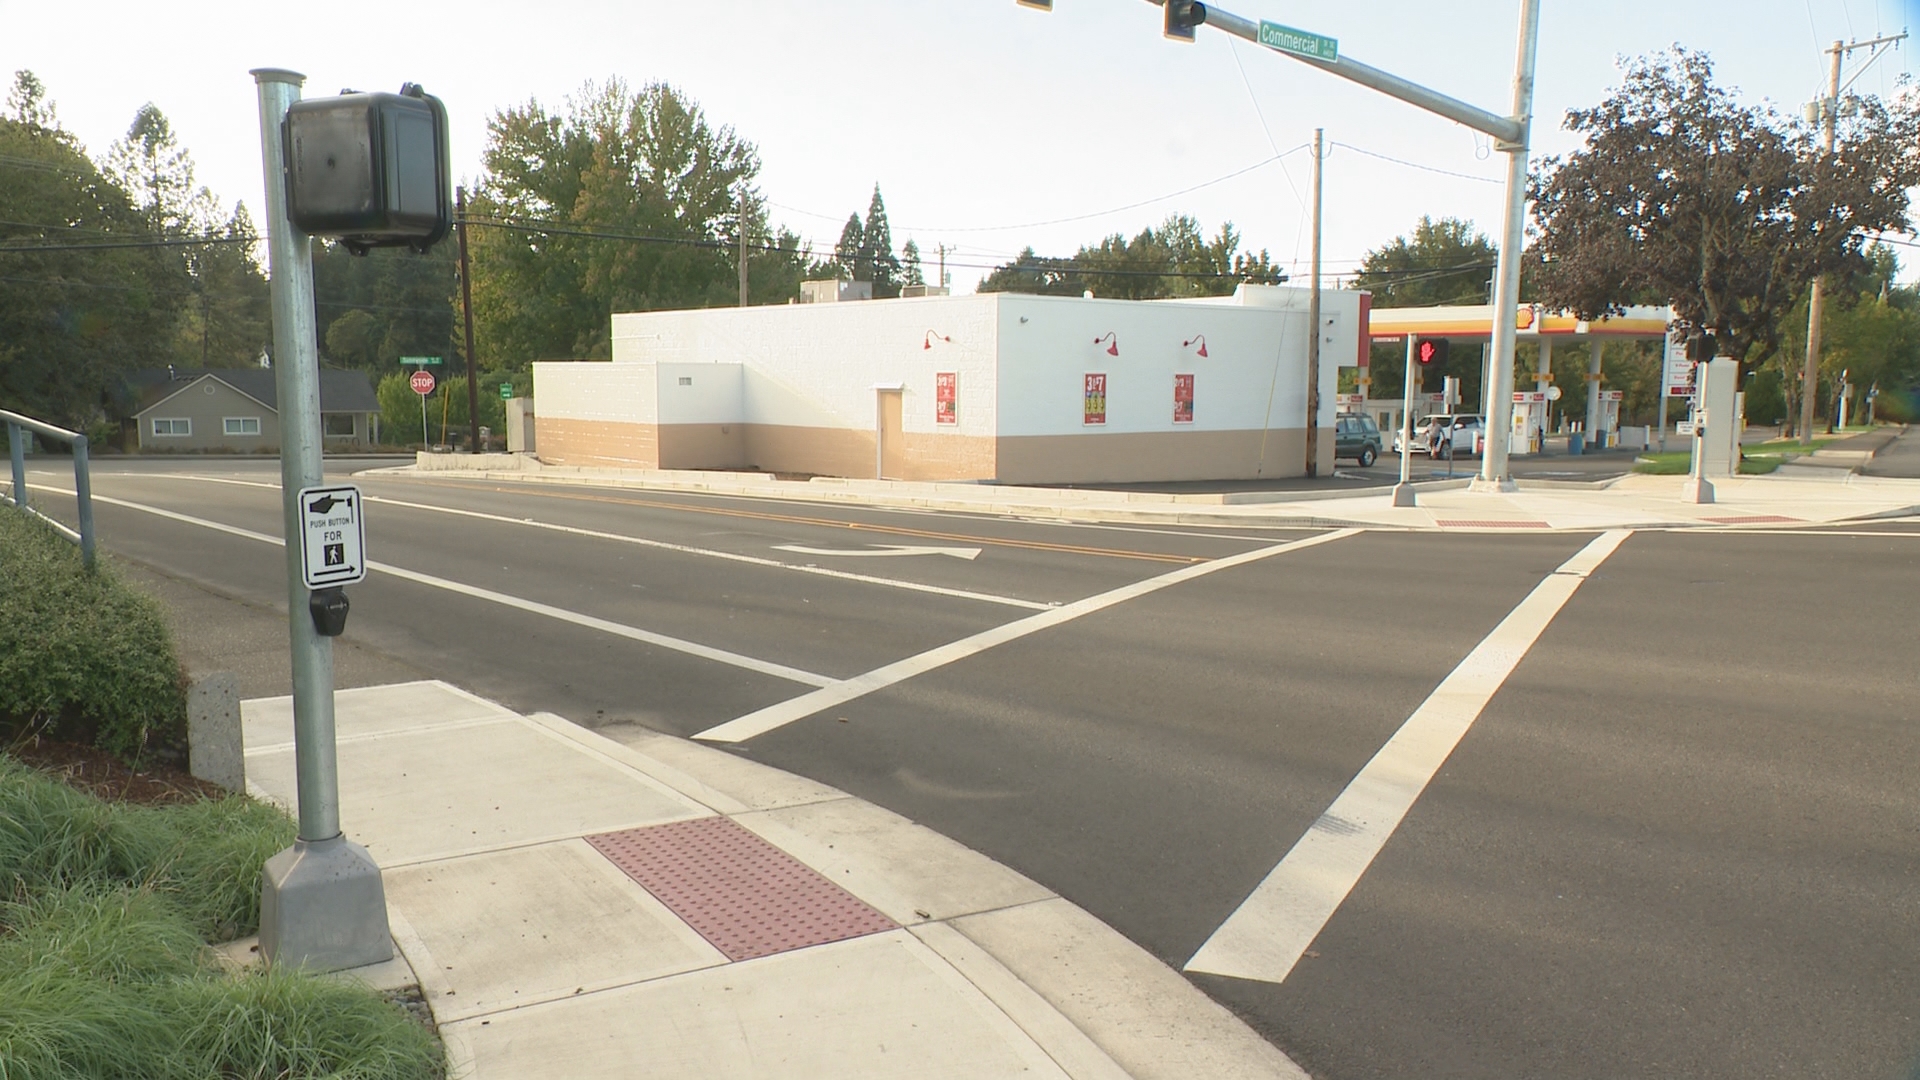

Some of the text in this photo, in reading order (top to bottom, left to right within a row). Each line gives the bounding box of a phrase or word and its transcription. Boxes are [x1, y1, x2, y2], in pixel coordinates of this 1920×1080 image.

[1262, 24, 1319, 54] Commercial
[412, 378, 433, 388] STOP
[1087, 376, 1092, 391] 3
[310, 517, 350, 529] PUSH BUTTON
[324, 530, 342, 541] FOR
